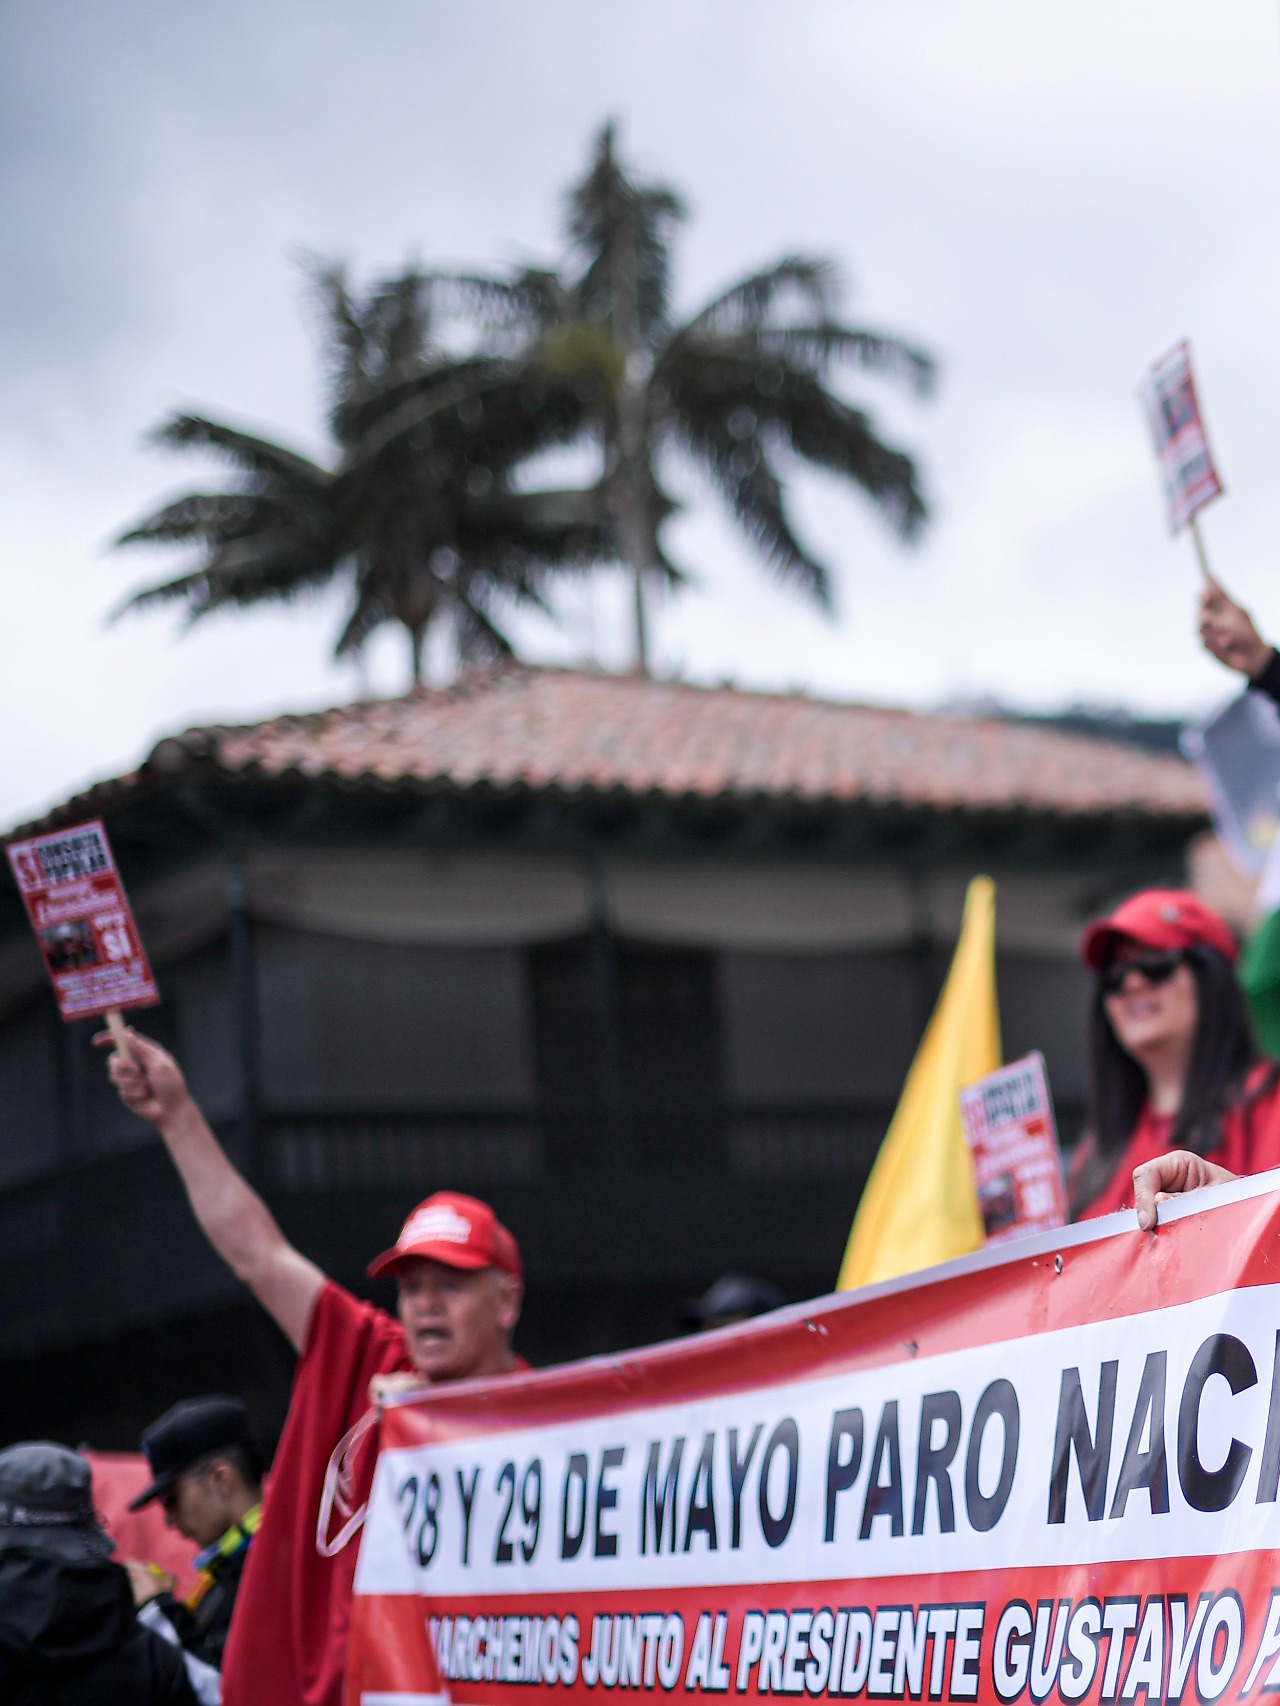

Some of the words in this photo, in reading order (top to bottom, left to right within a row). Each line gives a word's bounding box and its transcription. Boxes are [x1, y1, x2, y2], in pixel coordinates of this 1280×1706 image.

[399, 1476, 440, 1566] 28
[456, 1467, 480, 1565] Y
[496, 1459, 541, 1562] 29
[560, 1447, 625, 1560] DE
[641, 1417, 800, 1556] MAYO
[824, 1378, 1020, 1542] PARO
[582, 1610, 685, 1691] JUNTO
[685, 1611, 731, 1693] AL
[736, 1602, 986, 1703] PRESIDENTE
[992, 1587, 1245, 1706] GUSTAVO
